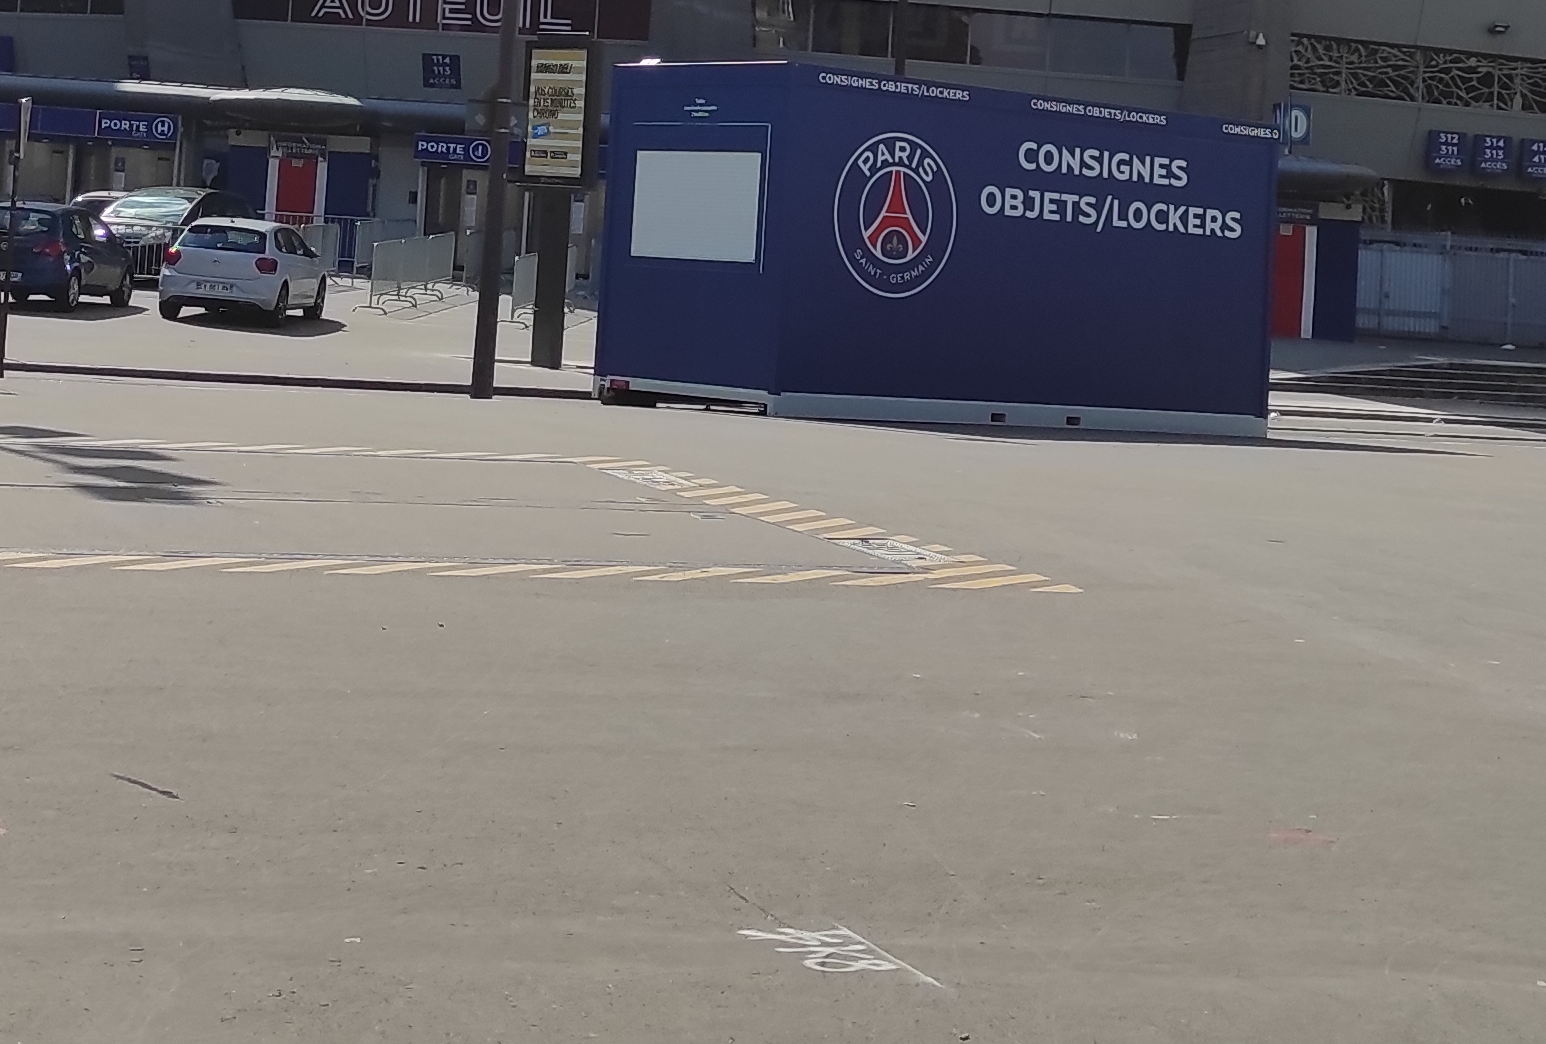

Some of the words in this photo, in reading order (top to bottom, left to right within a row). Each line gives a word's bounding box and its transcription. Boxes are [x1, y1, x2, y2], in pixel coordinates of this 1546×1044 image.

[431, 55, 451, 65] 114
[432, 66, 451, 75] 113
[818, 72, 879, 90] CONSIGNES
[880, 80, 970, 101] OBJETS/LOCKERS
[1030, 98, 1085, 115] CONSIGNES
[1086, 106, 1167, 125] OBJETS/LOCKERS
[101, 118, 148, 132] PORTE
[1222, 123, 1272, 139] CONSIGNES
[417, 140, 465, 155] PORTE
[1484, 137, 1505, 148] 314
[857, 140, 938, 183] PARIS
[1017, 141, 1189, 188] CONSIGNES
[979, 184, 1243, 240] OBJETS/LOCKERS
